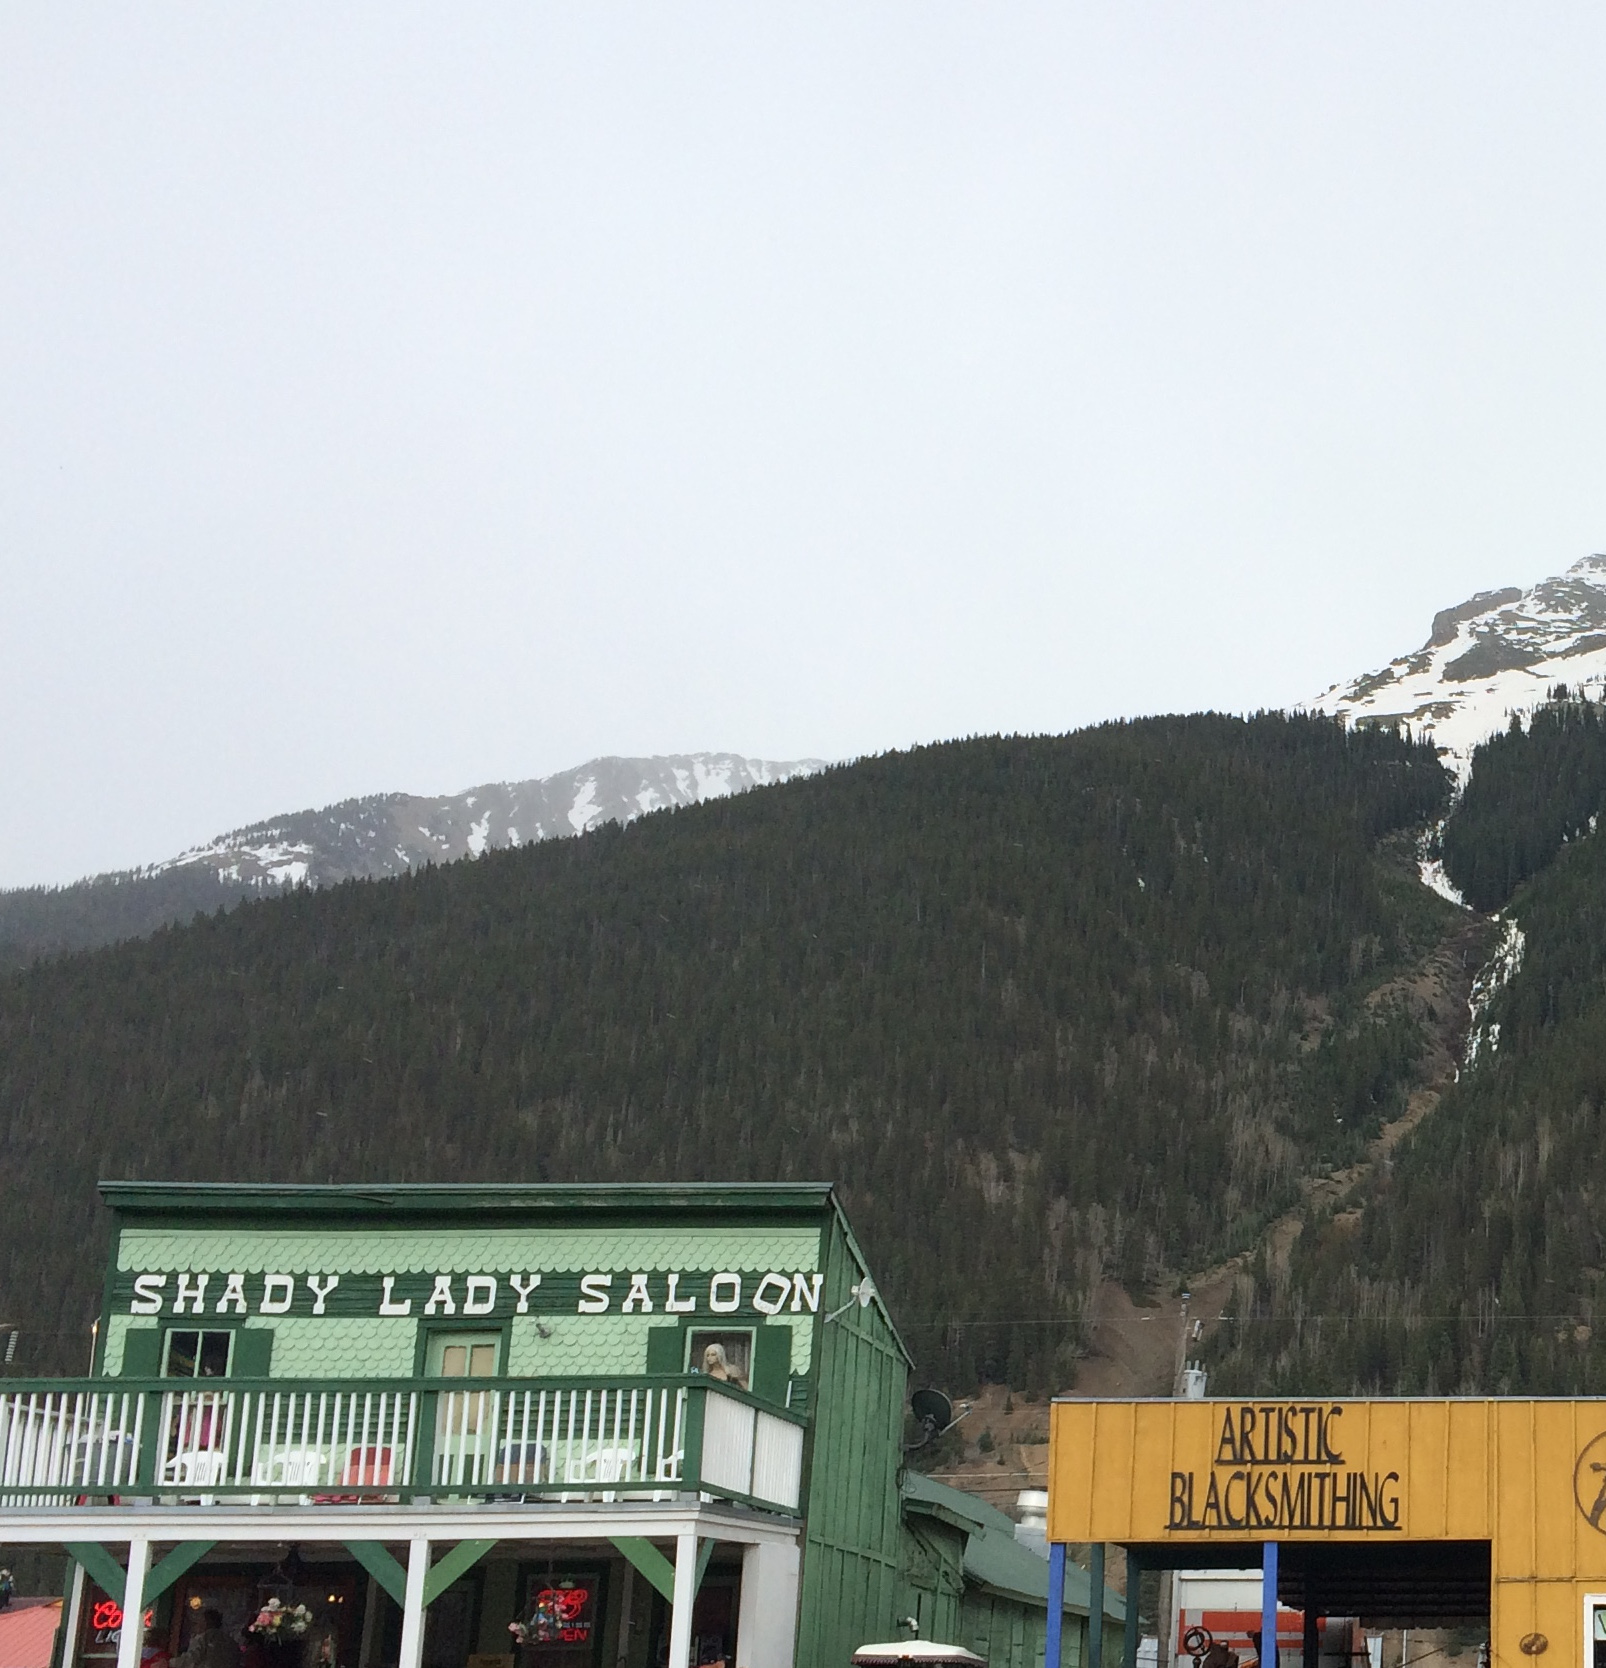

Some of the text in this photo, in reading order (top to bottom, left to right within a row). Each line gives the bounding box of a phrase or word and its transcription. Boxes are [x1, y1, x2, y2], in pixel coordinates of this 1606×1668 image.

[130, 1272, 824, 1316] SHADY LADY SALOON
[1215, 1405, 1345, 1463] ARTISTIC
[1167, 1470, 1401, 1530] BLACKSMITHING
